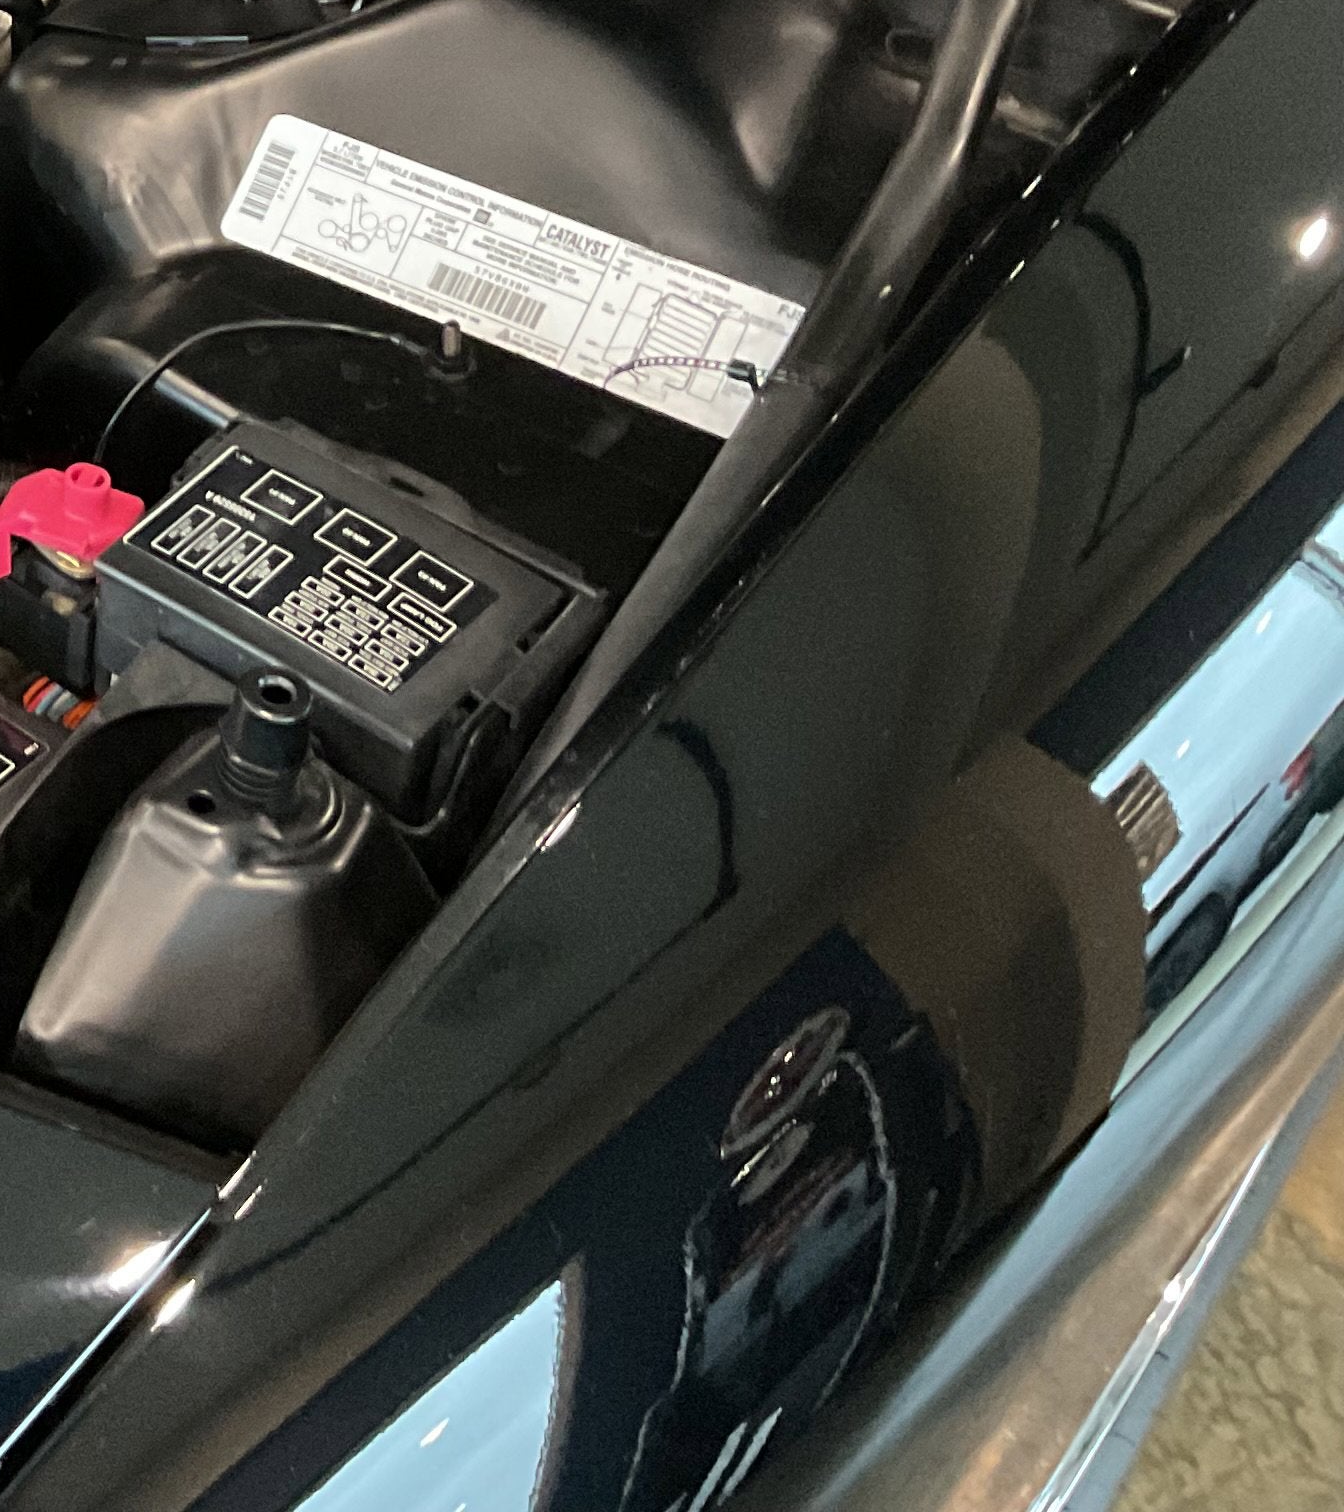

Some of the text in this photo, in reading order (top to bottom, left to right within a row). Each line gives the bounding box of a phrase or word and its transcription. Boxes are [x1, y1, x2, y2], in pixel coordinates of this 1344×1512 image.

[373, 158, 409, 178] VEHICLE
[408, 171, 448, 193] EMISSION
[446, 186, 486, 207] CONTROL
[486, 200, 544, 229] INFORMATION
[544, 223, 611, 260] CATALYST
